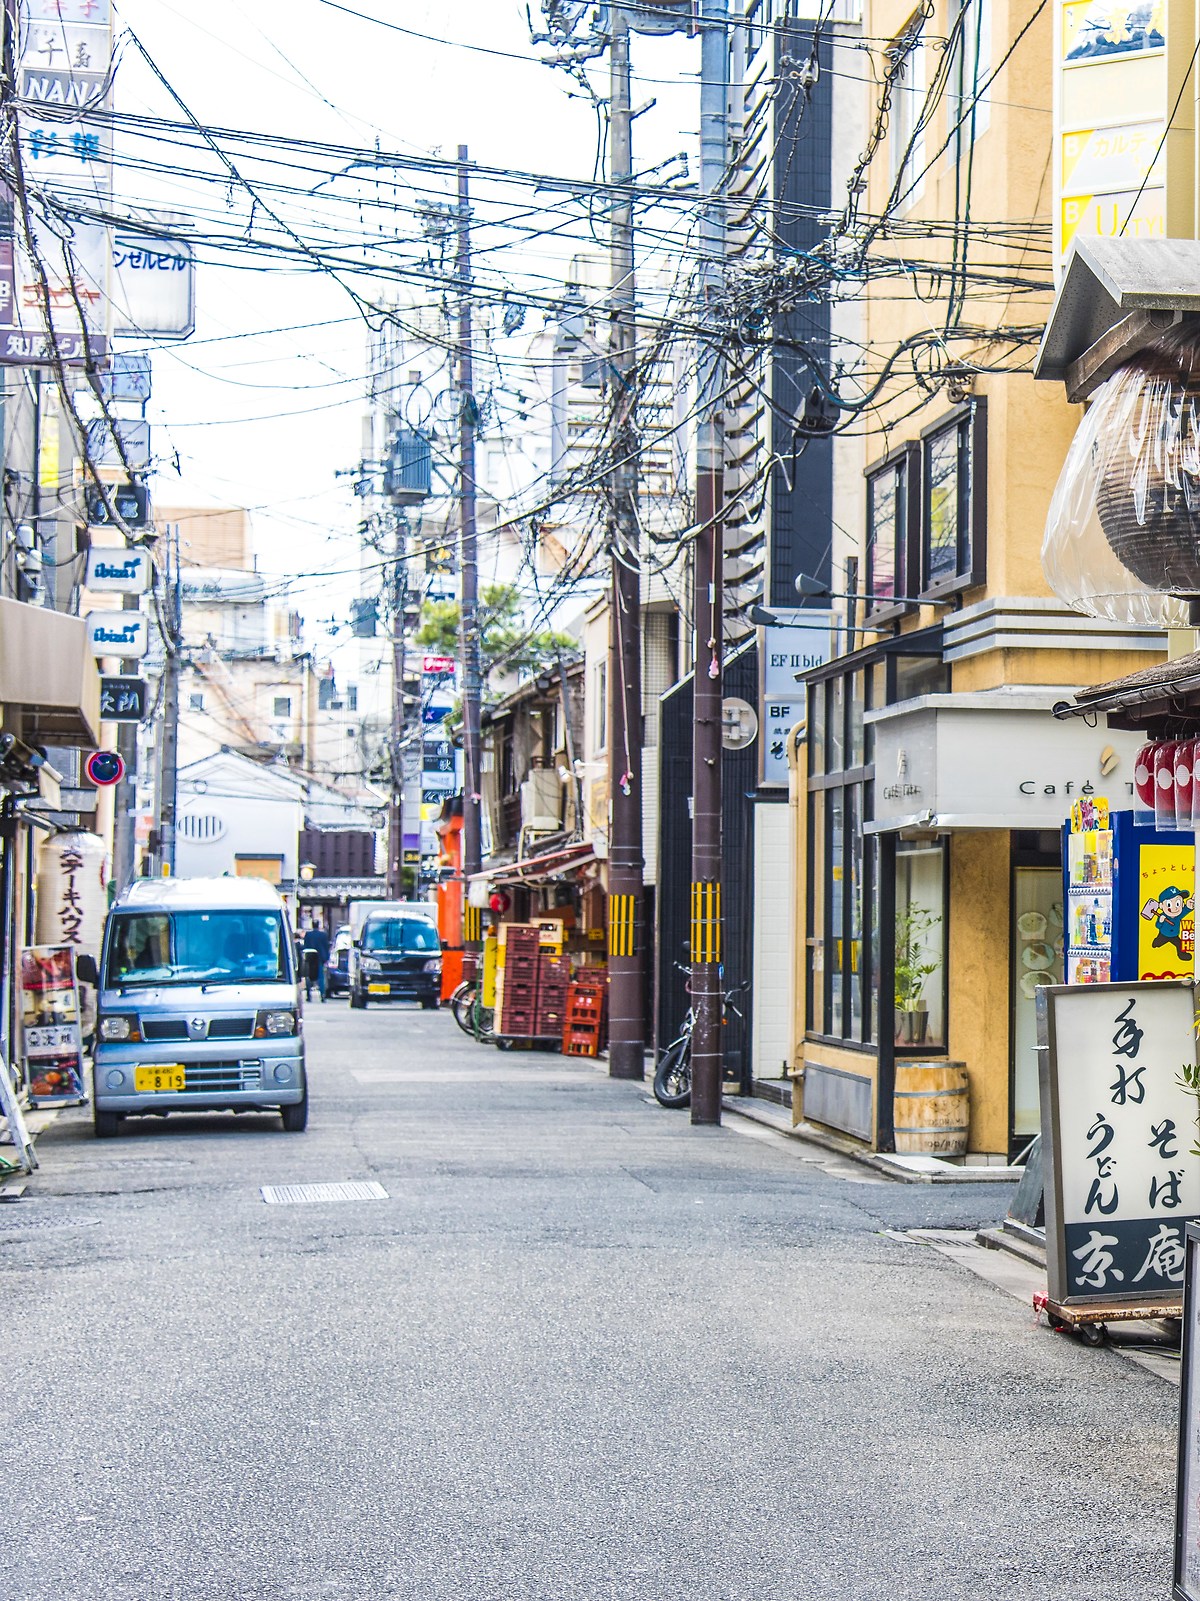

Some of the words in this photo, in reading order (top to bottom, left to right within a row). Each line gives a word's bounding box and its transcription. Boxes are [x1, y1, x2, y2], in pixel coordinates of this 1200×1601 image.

[770, 654, 788, 667] EF
[770, 706, 790, 718] BF
[1019, 780, 1095, 796] Café
[1110, 998, 1146, 1105] 手打
[1084, 1112, 1120, 1216] うどん
[1147, 1118, 1186, 1210] そば
